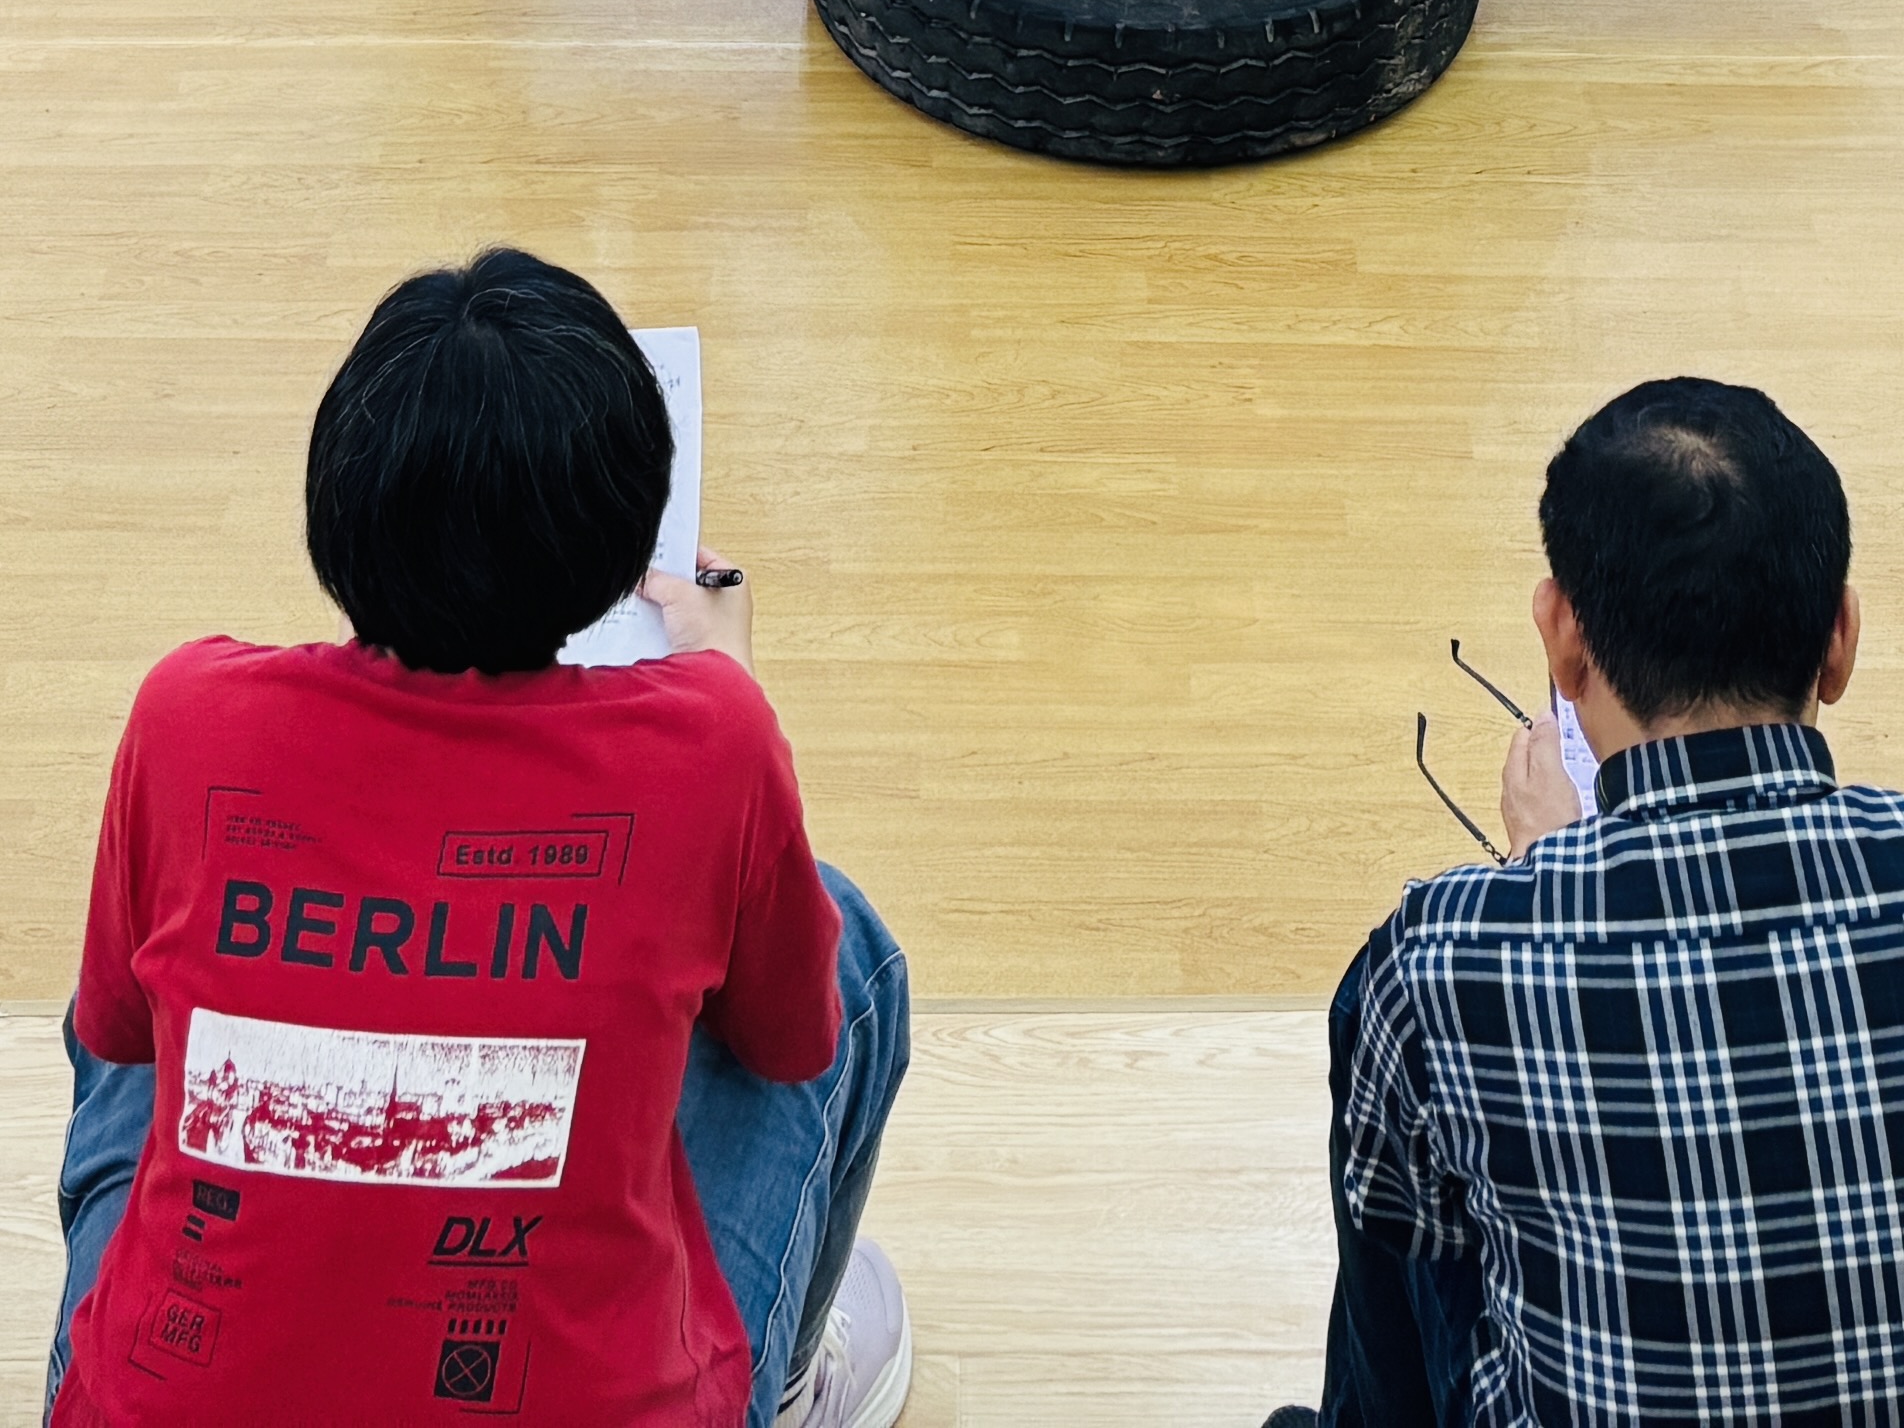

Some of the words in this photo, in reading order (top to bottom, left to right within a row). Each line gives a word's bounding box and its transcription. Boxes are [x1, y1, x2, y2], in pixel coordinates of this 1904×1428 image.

[527, 843, 589, 866] 1989
[215, 878, 589, 981] BERLIN
[432, 1215, 544, 1258] DLX
[161, 1323, 201, 1353] MFG
